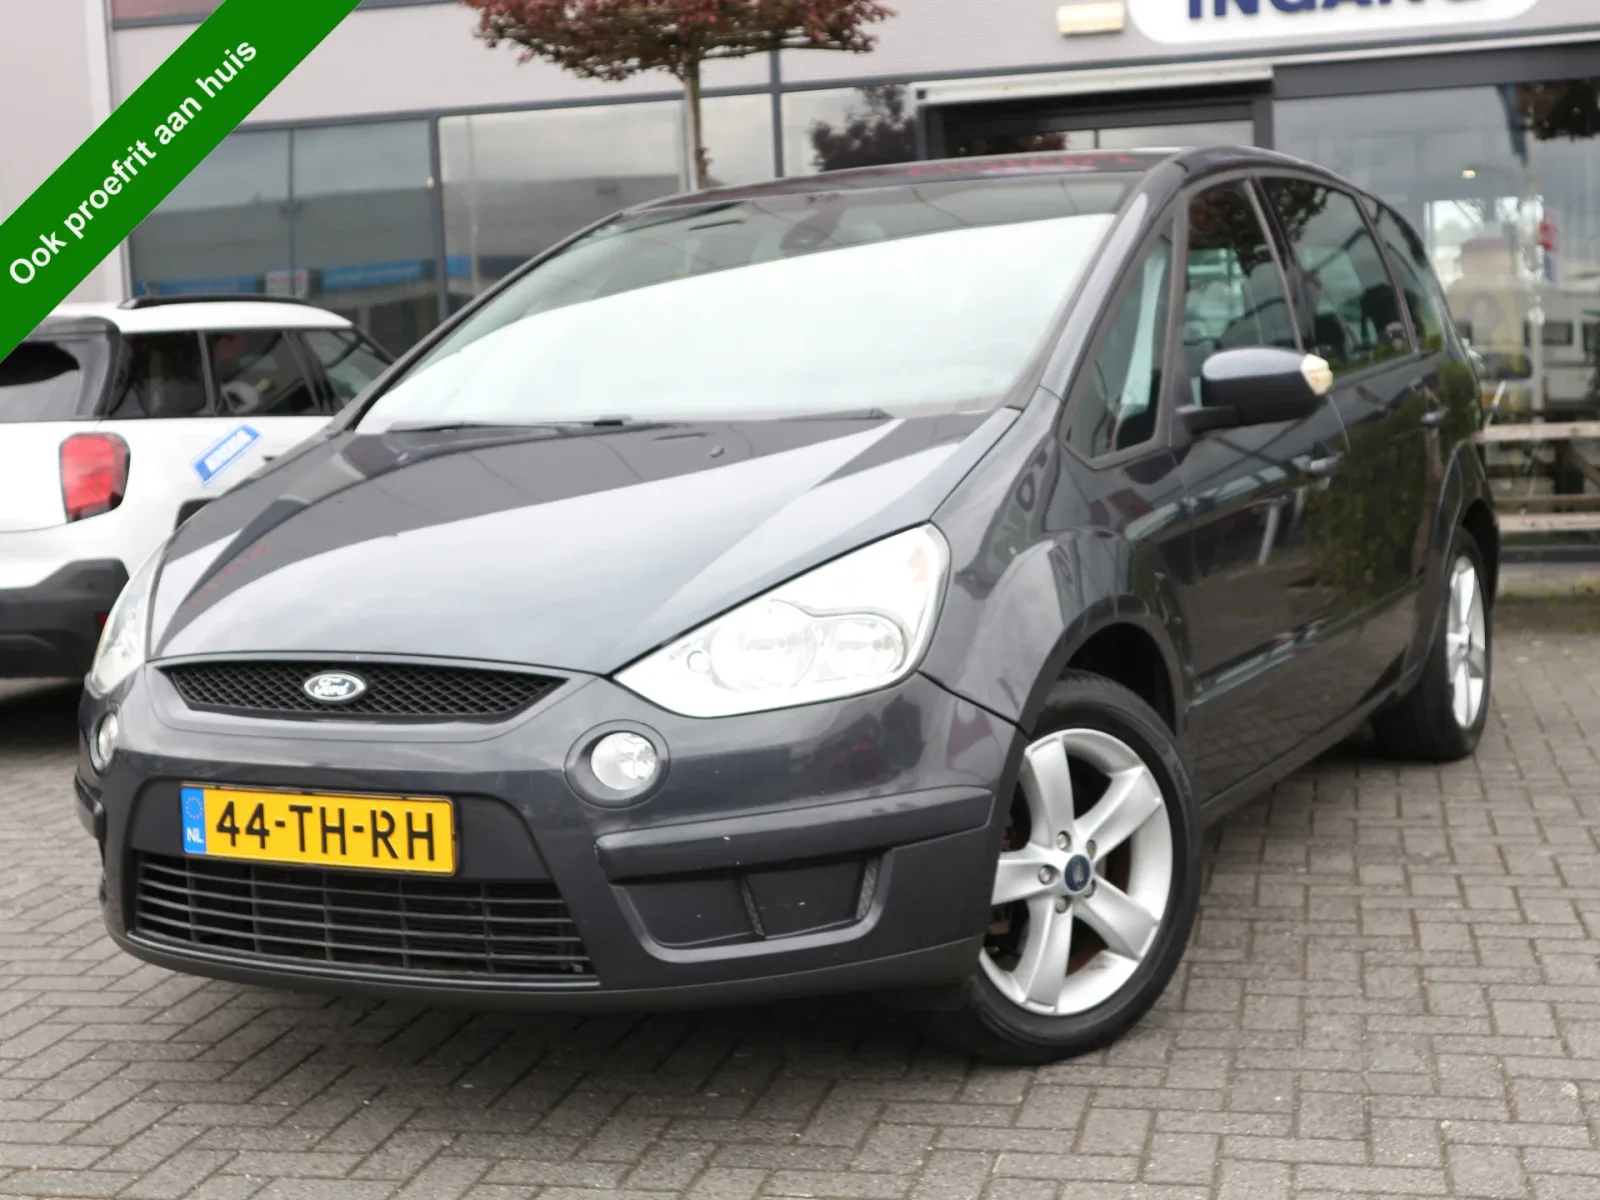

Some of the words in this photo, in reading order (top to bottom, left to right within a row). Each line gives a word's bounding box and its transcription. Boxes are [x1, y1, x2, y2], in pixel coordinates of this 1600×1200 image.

[314, 677, 351, 696] Ford
[186, 827, 204, 843] NL
[216, 801, 435, 861] 44-TH-RH
